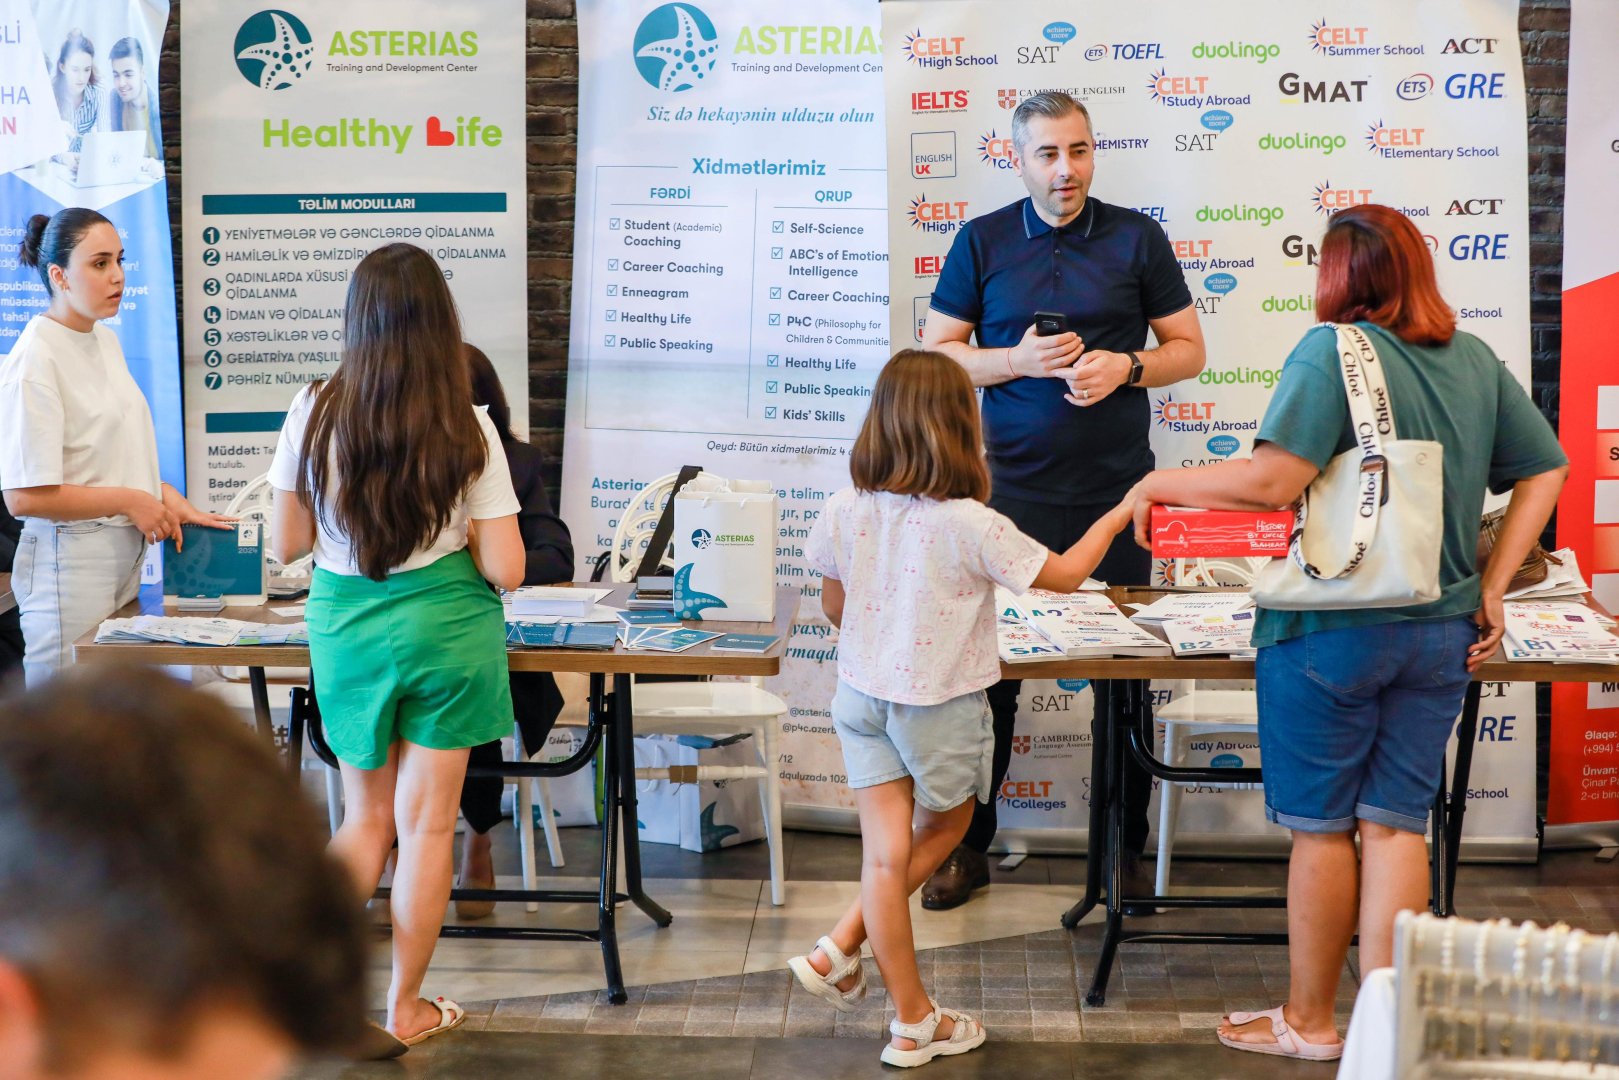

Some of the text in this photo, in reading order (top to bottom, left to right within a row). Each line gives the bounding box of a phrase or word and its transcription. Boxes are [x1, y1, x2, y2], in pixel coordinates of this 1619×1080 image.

[1317, 27, 1368, 45] CELT
[328, 31, 478, 57] ASTERIAS
[912, 37, 965, 56] CELT
[1112, 43, 1164, 60] TOEFL
[1328, 45, 1424, 56] Summer School
[1440, 38, 1498, 54] ACT
[1017, 46, 1059, 64] SAT
[1192, 41, 1280, 64] duolingo
[326, 63, 478, 74] Training and Development Center
[731, 62, 883, 75] Training and Development Cen
[923, 54, 998, 69] High School
[1083, 86, 1125, 95] ENGLISH
[1157, 76, 1209, 95] CELT
[1279, 72, 1368, 103] GMAT
[1403, 73, 1506, 99] ETS GRE
[911, 89, 968, 110] IELTS
[1166, 95, 1251, 108] Study Abroad
[646, 106, 875, 125] Siz də hekayənin ulduzu olun
[263, 118, 413, 154] Healthy
[1175, 134, 1217, 151] SAT
[1258, 132, 1346, 155] duolingo
[1374, 128, 1425, 147] CELT
[915, 154, 952, 163] ENGLISH
[1384, 147, 1500, 160] Elementary School
[692, 158, 826, 176] Xidmətlərimiz
[915, 164, 931, 175] UK
[650, 186, 691, 200] FƏRDİ
[814, 190, 852, 203] QRUP
[1320, 189, 1372, 208] CELT
[298, 197, 416, 210] TƏLİM MODULLARI
[1444, 199, 1502, 216] ACT
[916, 201, 969, 222] CELT
[1195, 204, 1284, 226] duolingo
[224, 227, 316, 240] YENİYETMƏLƏR
[319, 228, 336, 239] VƏ
[340, 227, 422, 239] GƏNCLƏRDƏ
[425, 225, 495, 239] QİDALANMA
[624, 219, 722, 233] Student (Academic)
[790, 223, 864, 235] Self-Science
[927, 221, 956, 234] High
[624, 235, 681, 249] Coaching
[1170, 240, 1213, 258] ELT
[1449, 234, 1509, 261] GRE
[206, 250, 217, 264] 2
[225, 248, 290, 261] HAMİLƏLİK
[292, 250, 309, 261] VƏ
[437, 247, 507, 259] QİDALANMA
[826, 250, 839, 261] of
[842, 250, 889, 261] Emotion
[623, 261, 724, 276] Career Coaching
[788, 265, 858, 279] Intelligence
[1179, 257, 1255, 272] tudy Abroad
[207, 269, 348, 294] 3 QADINLARDA XÜSUSİ
[226, 287, 298, 300] QİDALANMA
[622, 286, 689, 300] Enneagram
[787, 290, 890, 306] Career Coaching
[206, 308, 285, 322] 4 İDMAN VƏ
[621, 312, 692, 326] Healthy Life
[1460, 307, 1502, 318] School
[787, 316, 881, 331] P4C (Philosophy for
[207, 331, 219, 345] 5
[226, 329, 308, 342] XƏSTƏLİKLƏR
[311, 330, 328, 341] VƏ
[786, 334, 889, 346] Children & Communitie
[620, 338, 713, 353] Public Speaking
[207, 351, 295, 366] 6 GERİATRİYA
[785, 357, 857, 371] Healthy Life
[207, 372, 272, 388] 7 PƏHRİZ
[1343, 351, 1364, 398] Chloé
[784, 383, 871, 397] Public Speakin
[814, 410, 845, 421] Skills
[1163, 402, 1216, 421] CELT
[1376, 387, 1391, 435] Chloé
[1173, 419, 1257, 434] Study Abroad
[208, 446, 260, 456] Müddət:
[706, 440, 737, 453] Qeyd:
[739, 442, 768, 452] Bütün
[770, 443, 837, 456] xidmətlərimiz
[208, 460, 245, 469] tutulub.
[208, 478, 248, 489] Bədən
[791, 487, 824, 500] təlim
[1179, 641, 1214, 650] B2
[1032, 694, 1074, 712] SAT
[1033, 734, 1092, 743] CAMBRIDGE
[1584, 730, 1617, 741] Əlaqə:
[1583, 745, 1613, 756] (+994)
[1582, 764, 1618, 776] Ünvan:
[1002, 781, 1053, 798] CELT
[1581, 779, 1607, 789] Çinar
[1466, 788, 1509, 799] School
[1581, 791, 1600, 800] 2-ci
[1012, 798, 1066, 811] Colleges
